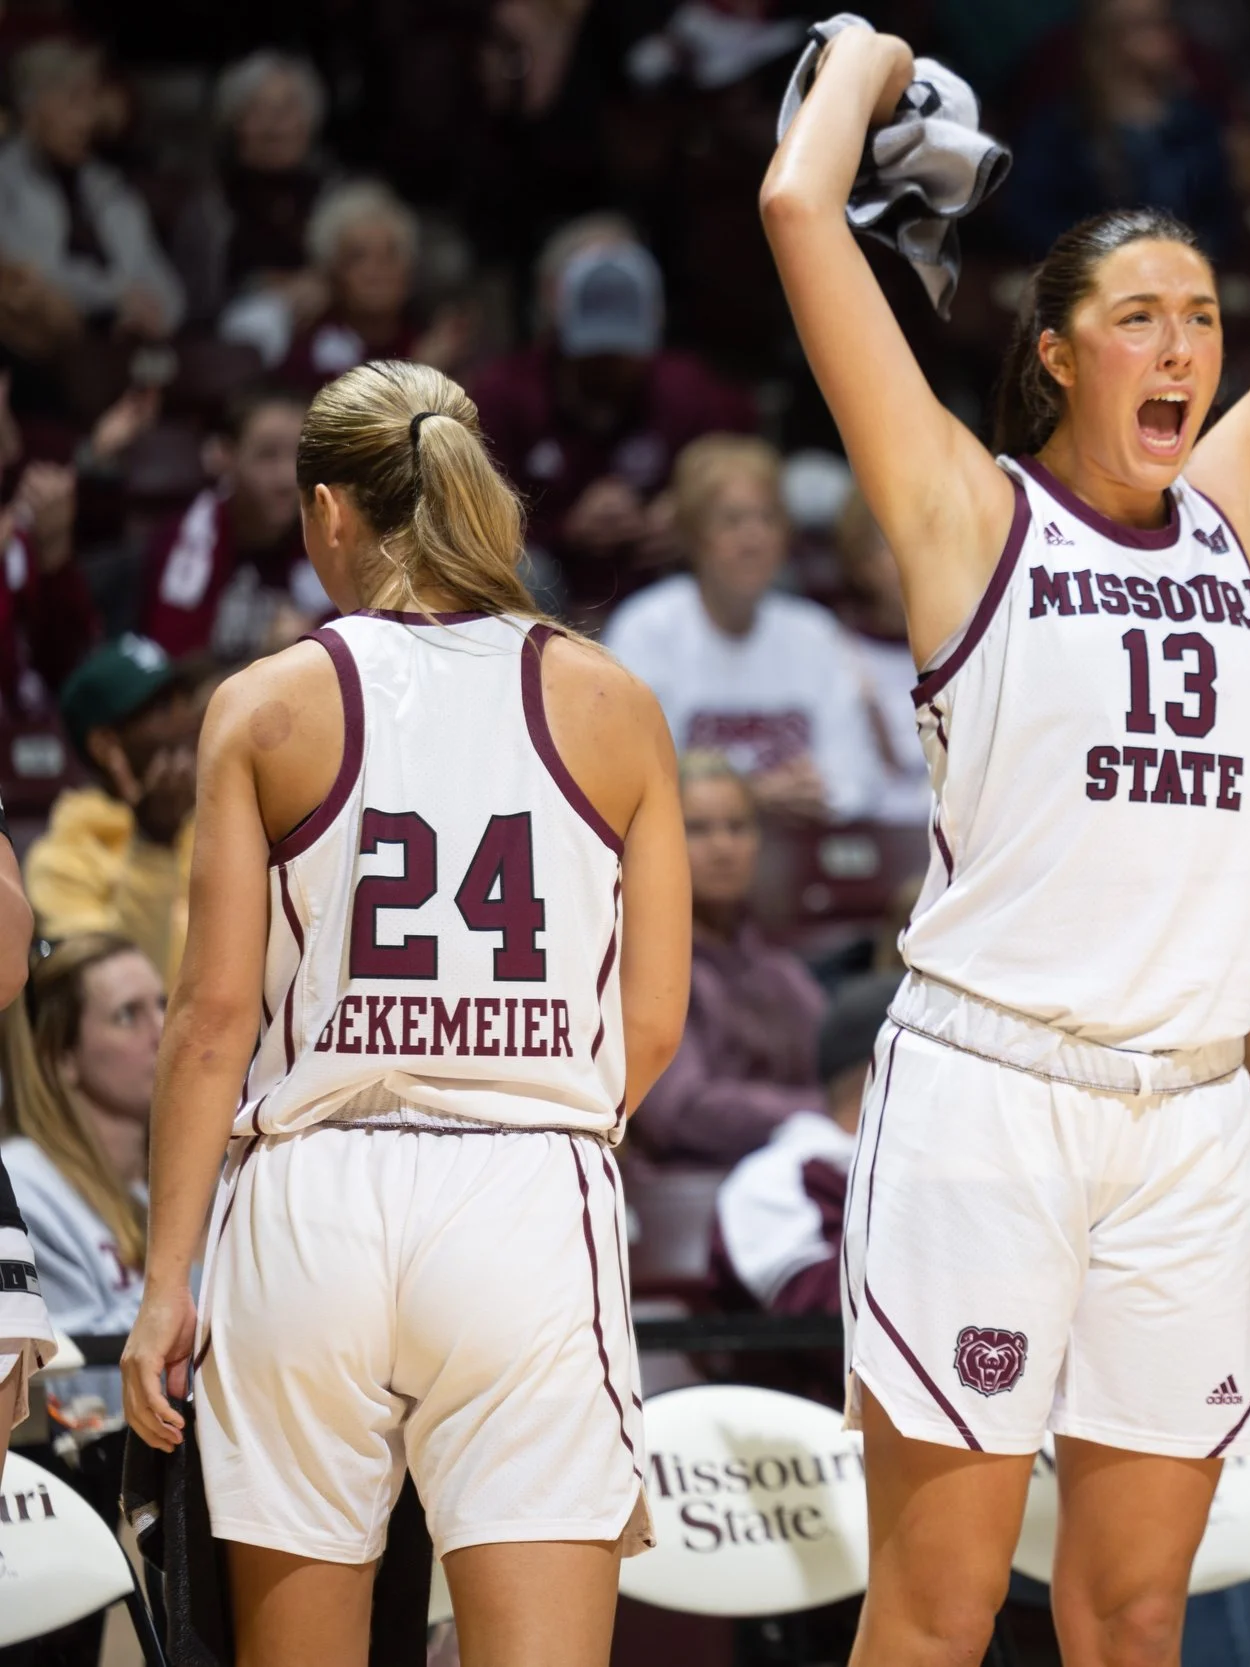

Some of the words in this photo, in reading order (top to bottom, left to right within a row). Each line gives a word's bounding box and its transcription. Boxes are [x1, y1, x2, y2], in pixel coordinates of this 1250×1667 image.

[1122, 628, 1218, 739] 13
[1086, 745, 1244, 812] STATE
[349, 807, 547, 982] 24
[1206, 1394, 1243, 1405] adidas
[680, 1500, 823, 1554] State
